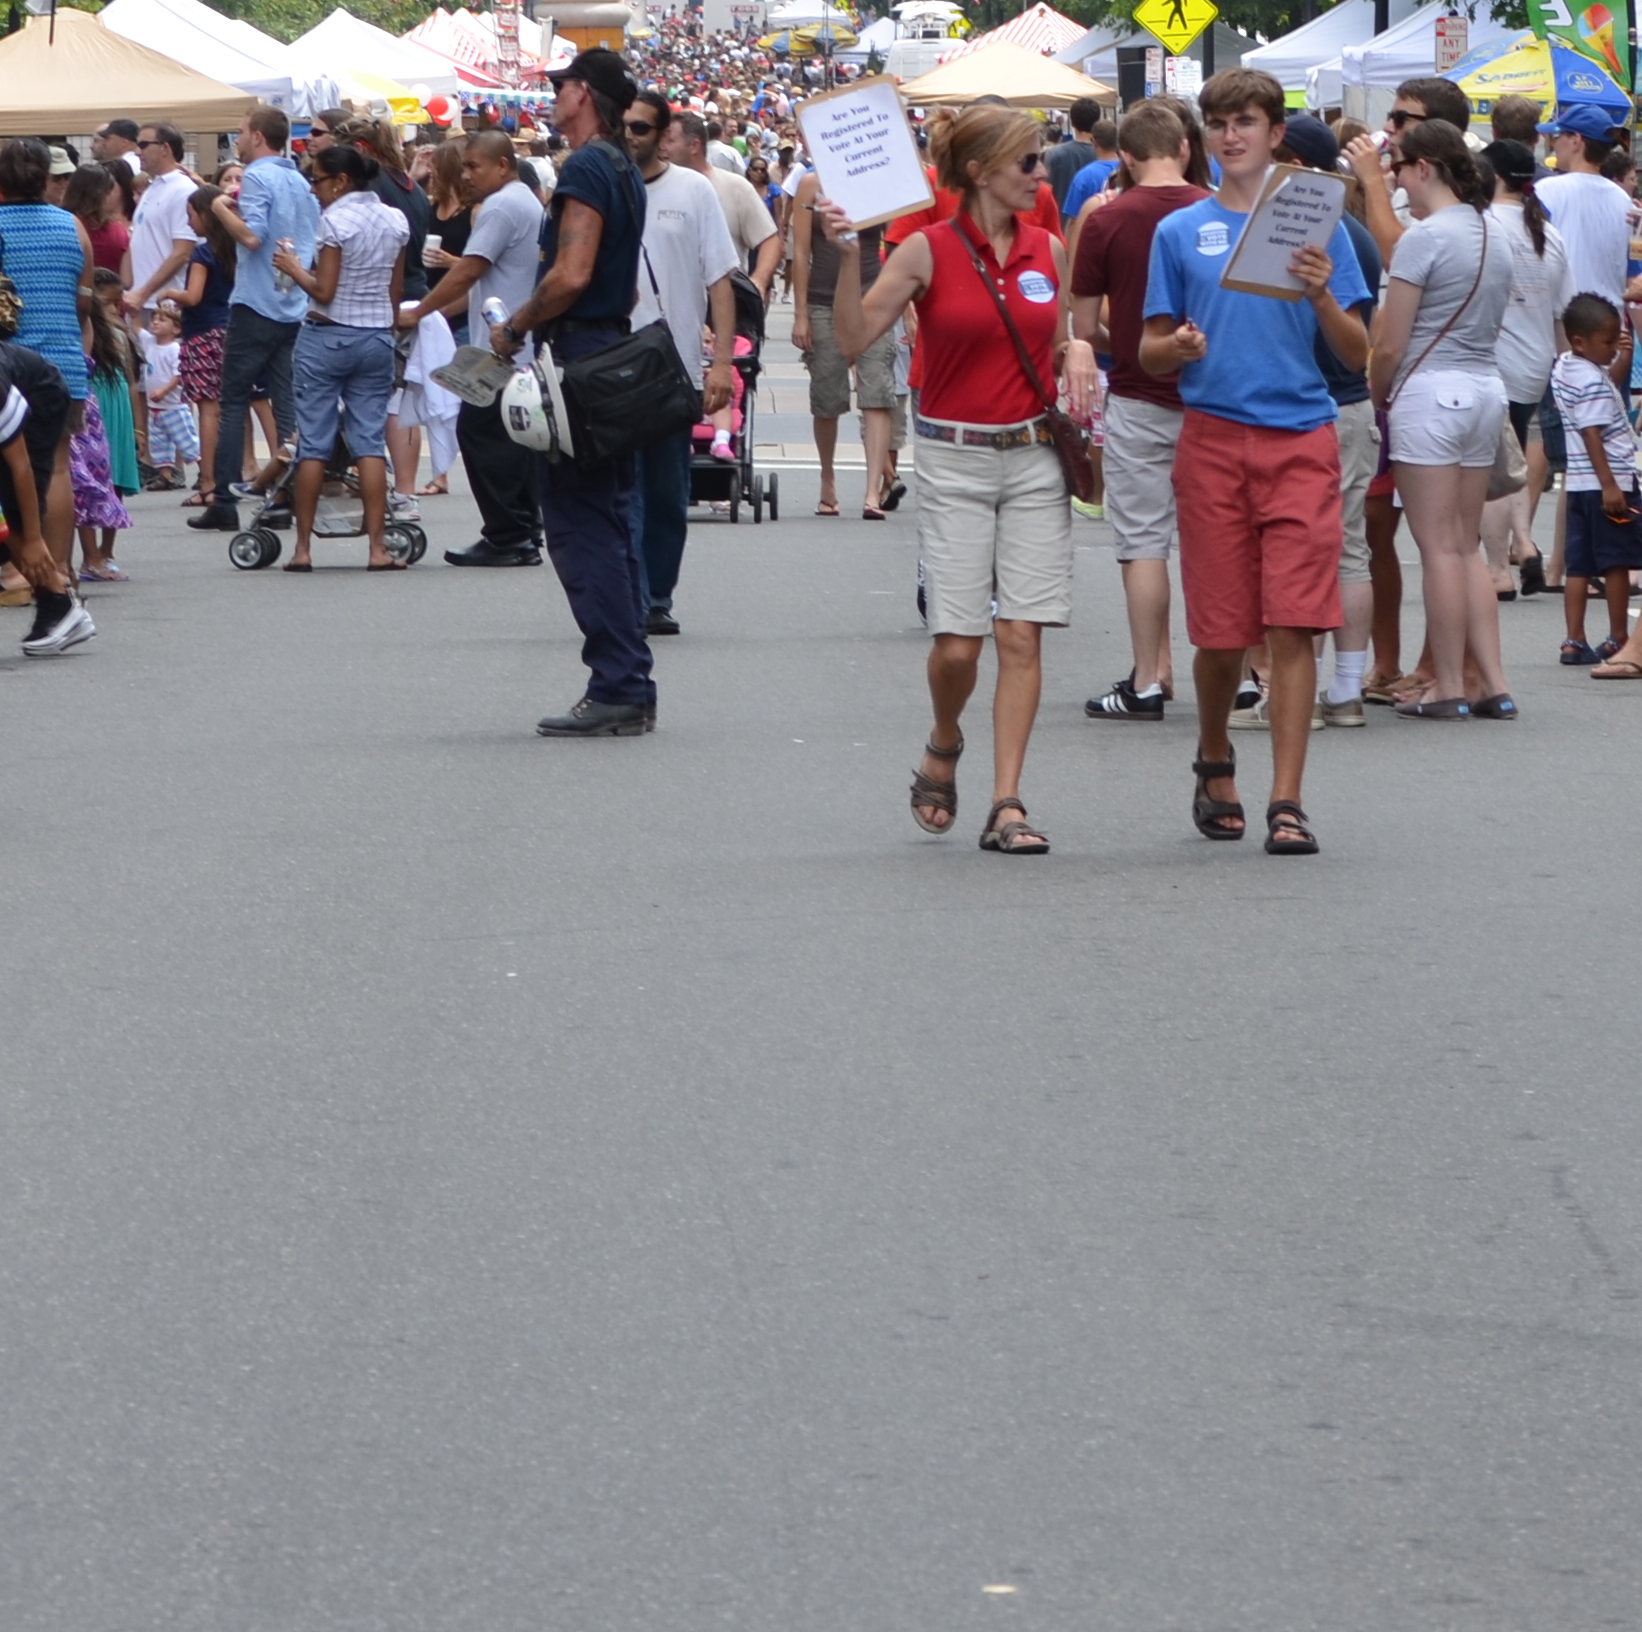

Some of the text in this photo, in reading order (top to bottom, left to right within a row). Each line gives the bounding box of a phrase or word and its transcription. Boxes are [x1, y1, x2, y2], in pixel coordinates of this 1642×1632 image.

[1442, 38, 1461, 49] ANY
[831, 105, 870, 122] Are You
[820, 118, 874, 140] Registered
[845, 145, 883, 163] Current
